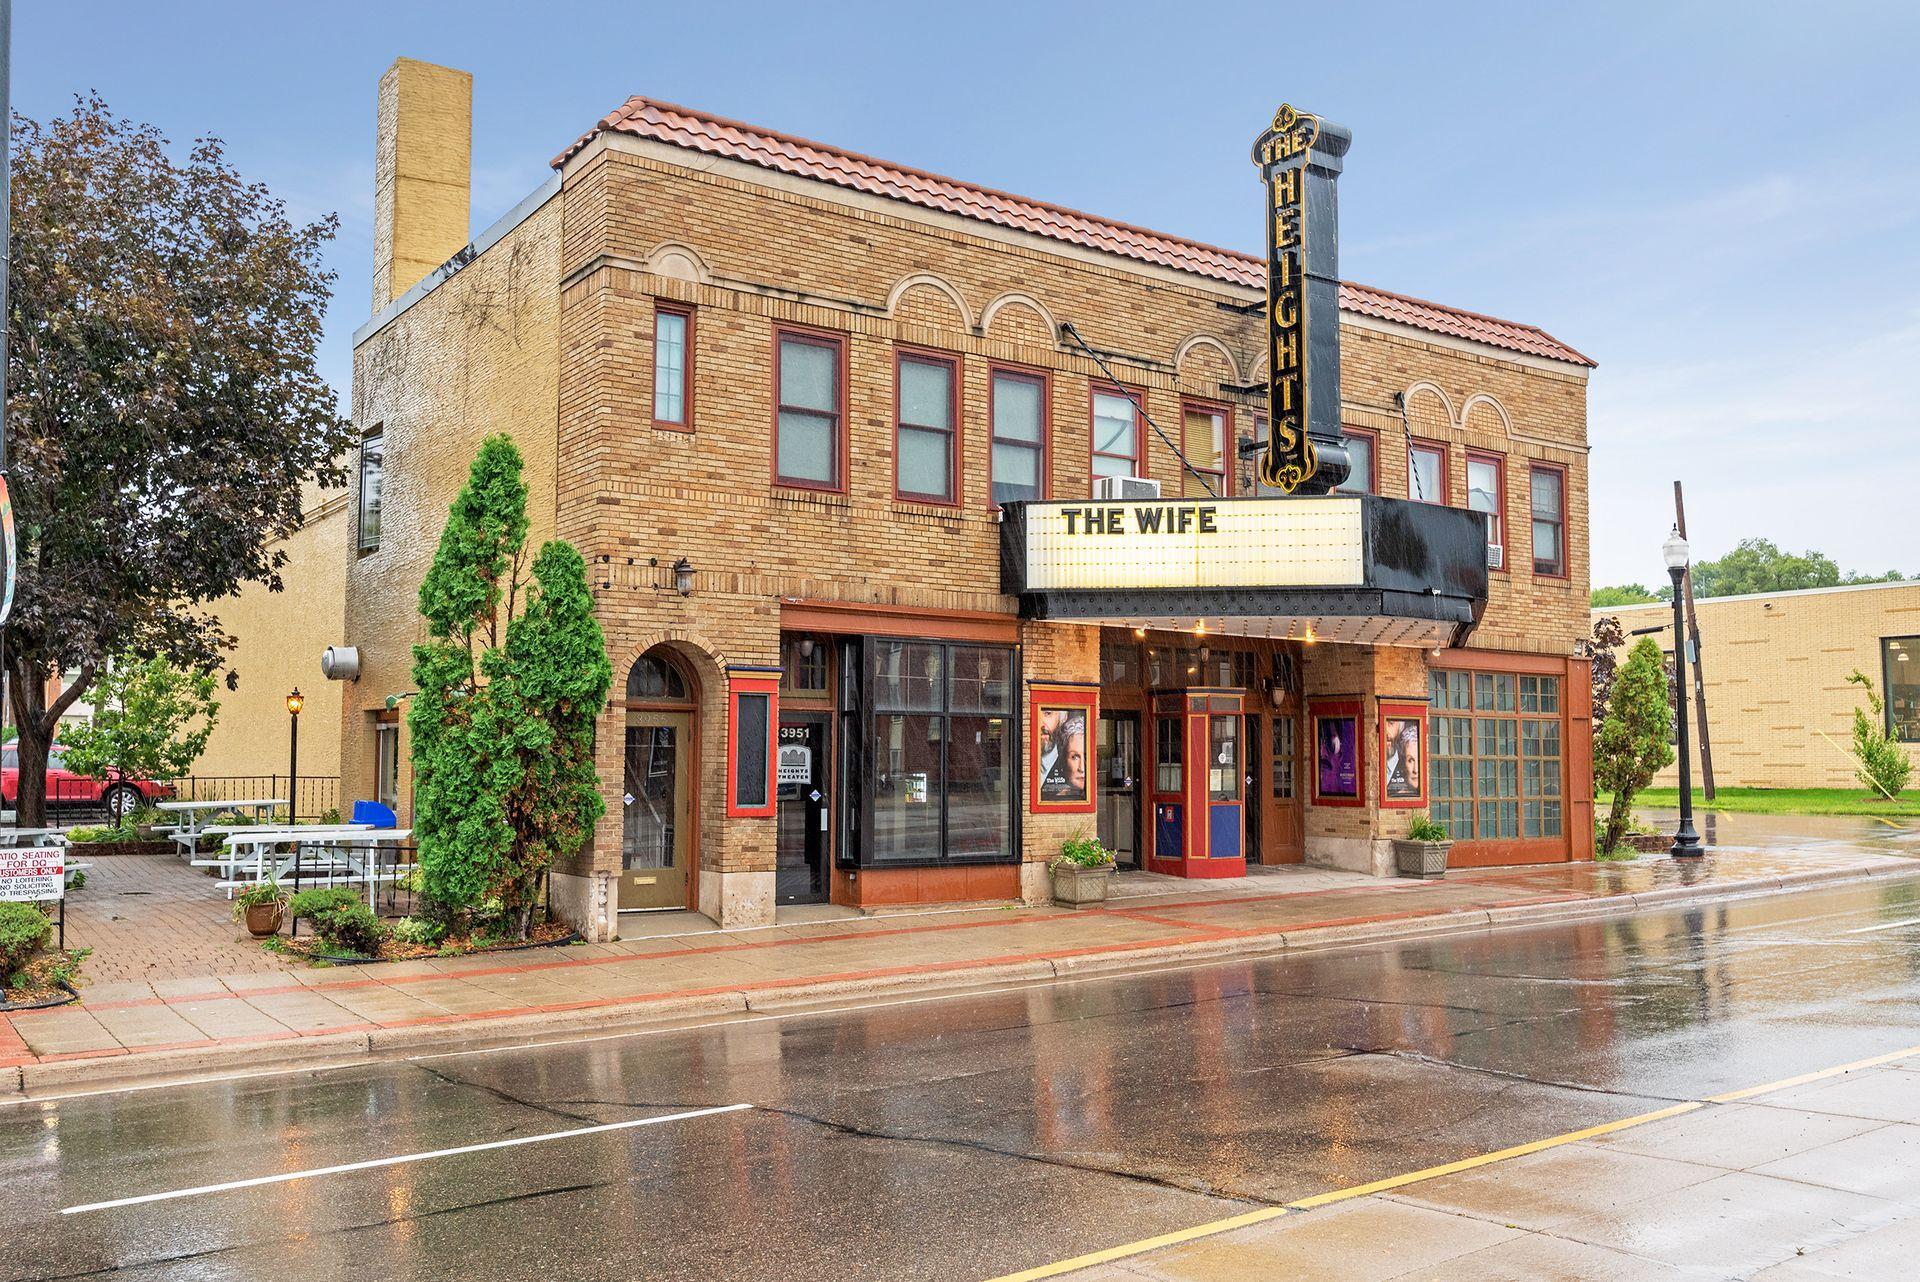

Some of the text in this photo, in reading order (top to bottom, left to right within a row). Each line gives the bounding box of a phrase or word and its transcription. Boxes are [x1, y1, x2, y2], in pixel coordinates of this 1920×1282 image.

[1261, 127, 1307, 165] THE
[1274, 169, 1298, 452] HEIGHTS
[1061, 506, 1217, 535] THE WIFE
[781, 727, 810, 738] 3951
[0, 851, 60, 861] ATIO SEATING
[0, 867, 58, 876] USTOMERS ONLY
[10, 888, 58, 896] TRESPASSING
